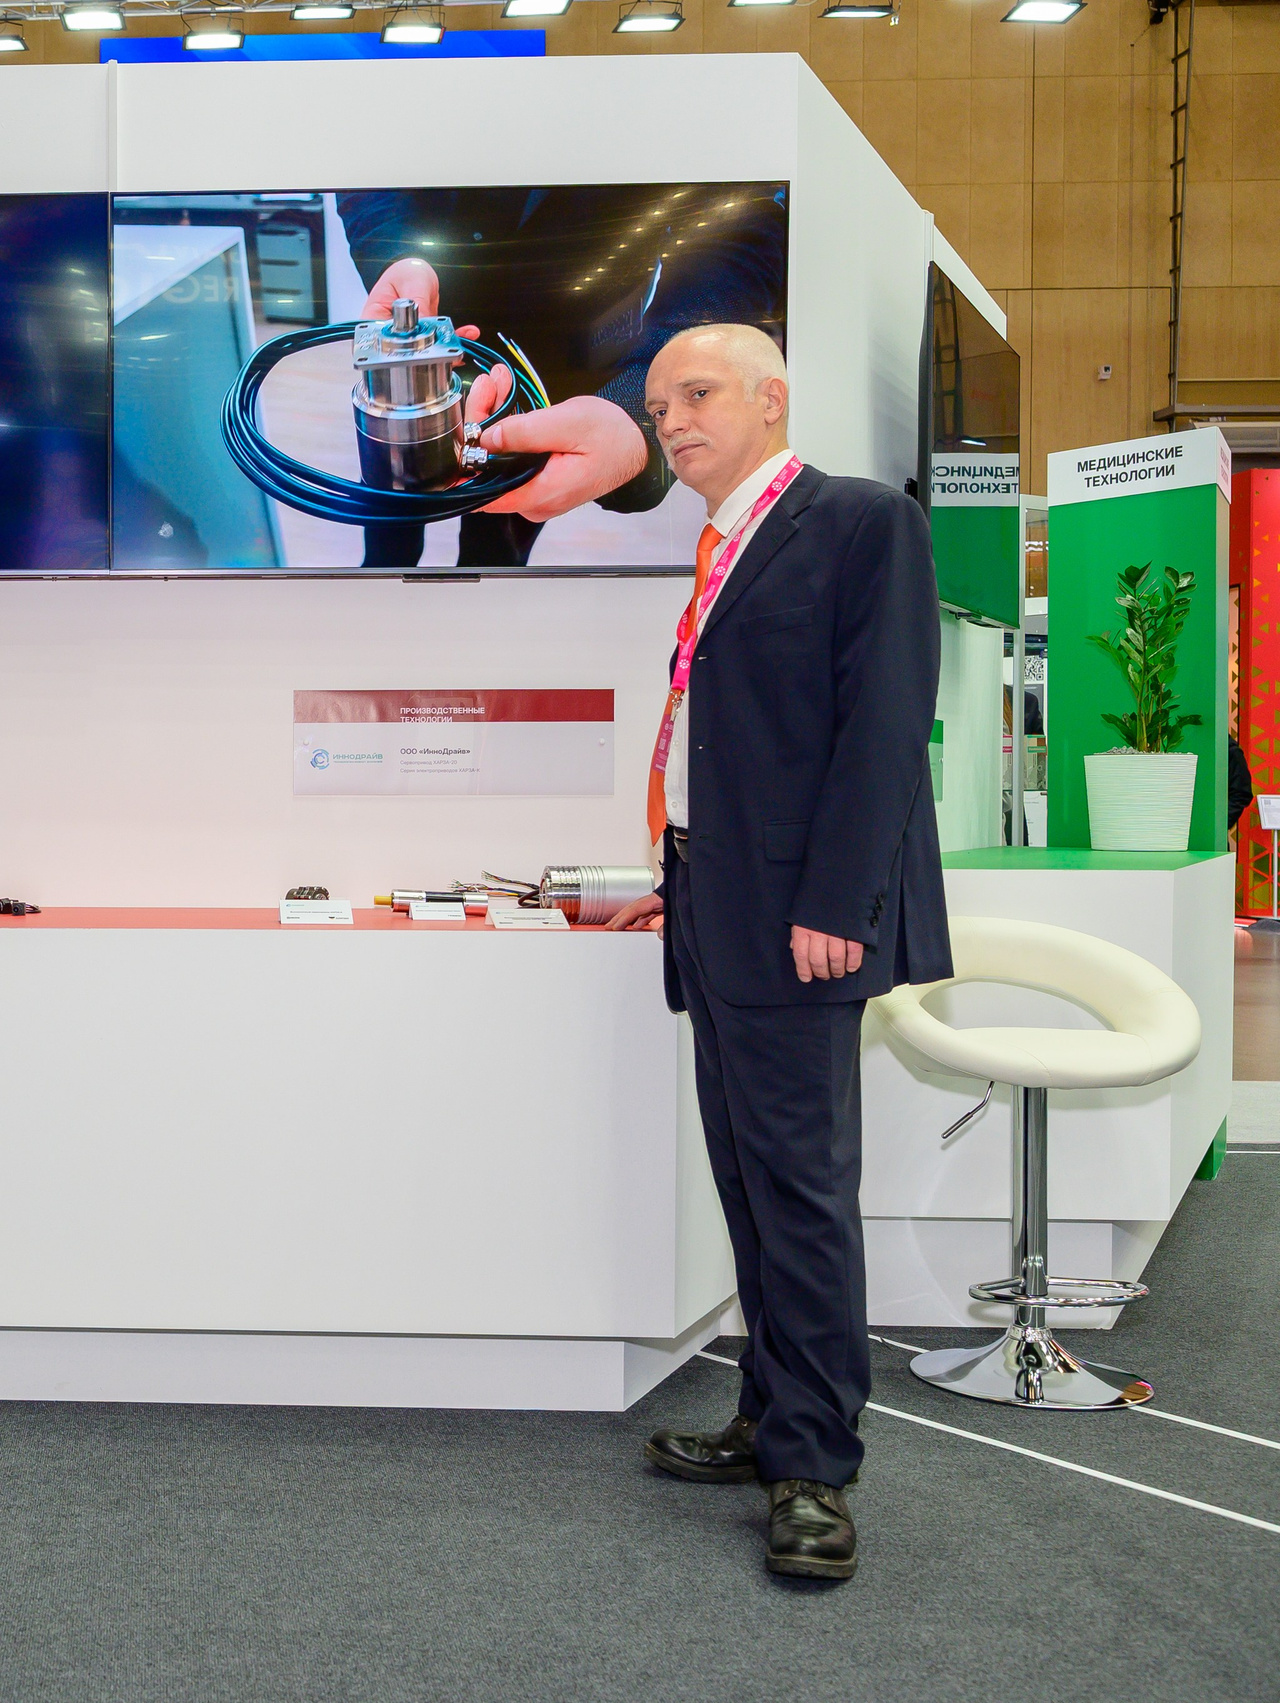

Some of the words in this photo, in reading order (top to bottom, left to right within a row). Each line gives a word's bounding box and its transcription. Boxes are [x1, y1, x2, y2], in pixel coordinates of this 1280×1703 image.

[1077, 445, 1183, 473] МЕДИЦИНСКИЕ
[1084, 464, 1175, 488] ТЕХНОЛОГИИ
[399, 707, 485, 715] ПРОИЗВОДСТВЕННЫЕ
[332, 752, 383, 760] ИННОДРАЙВ
[419, 747, 471, 756] «ИнноДрайв»
